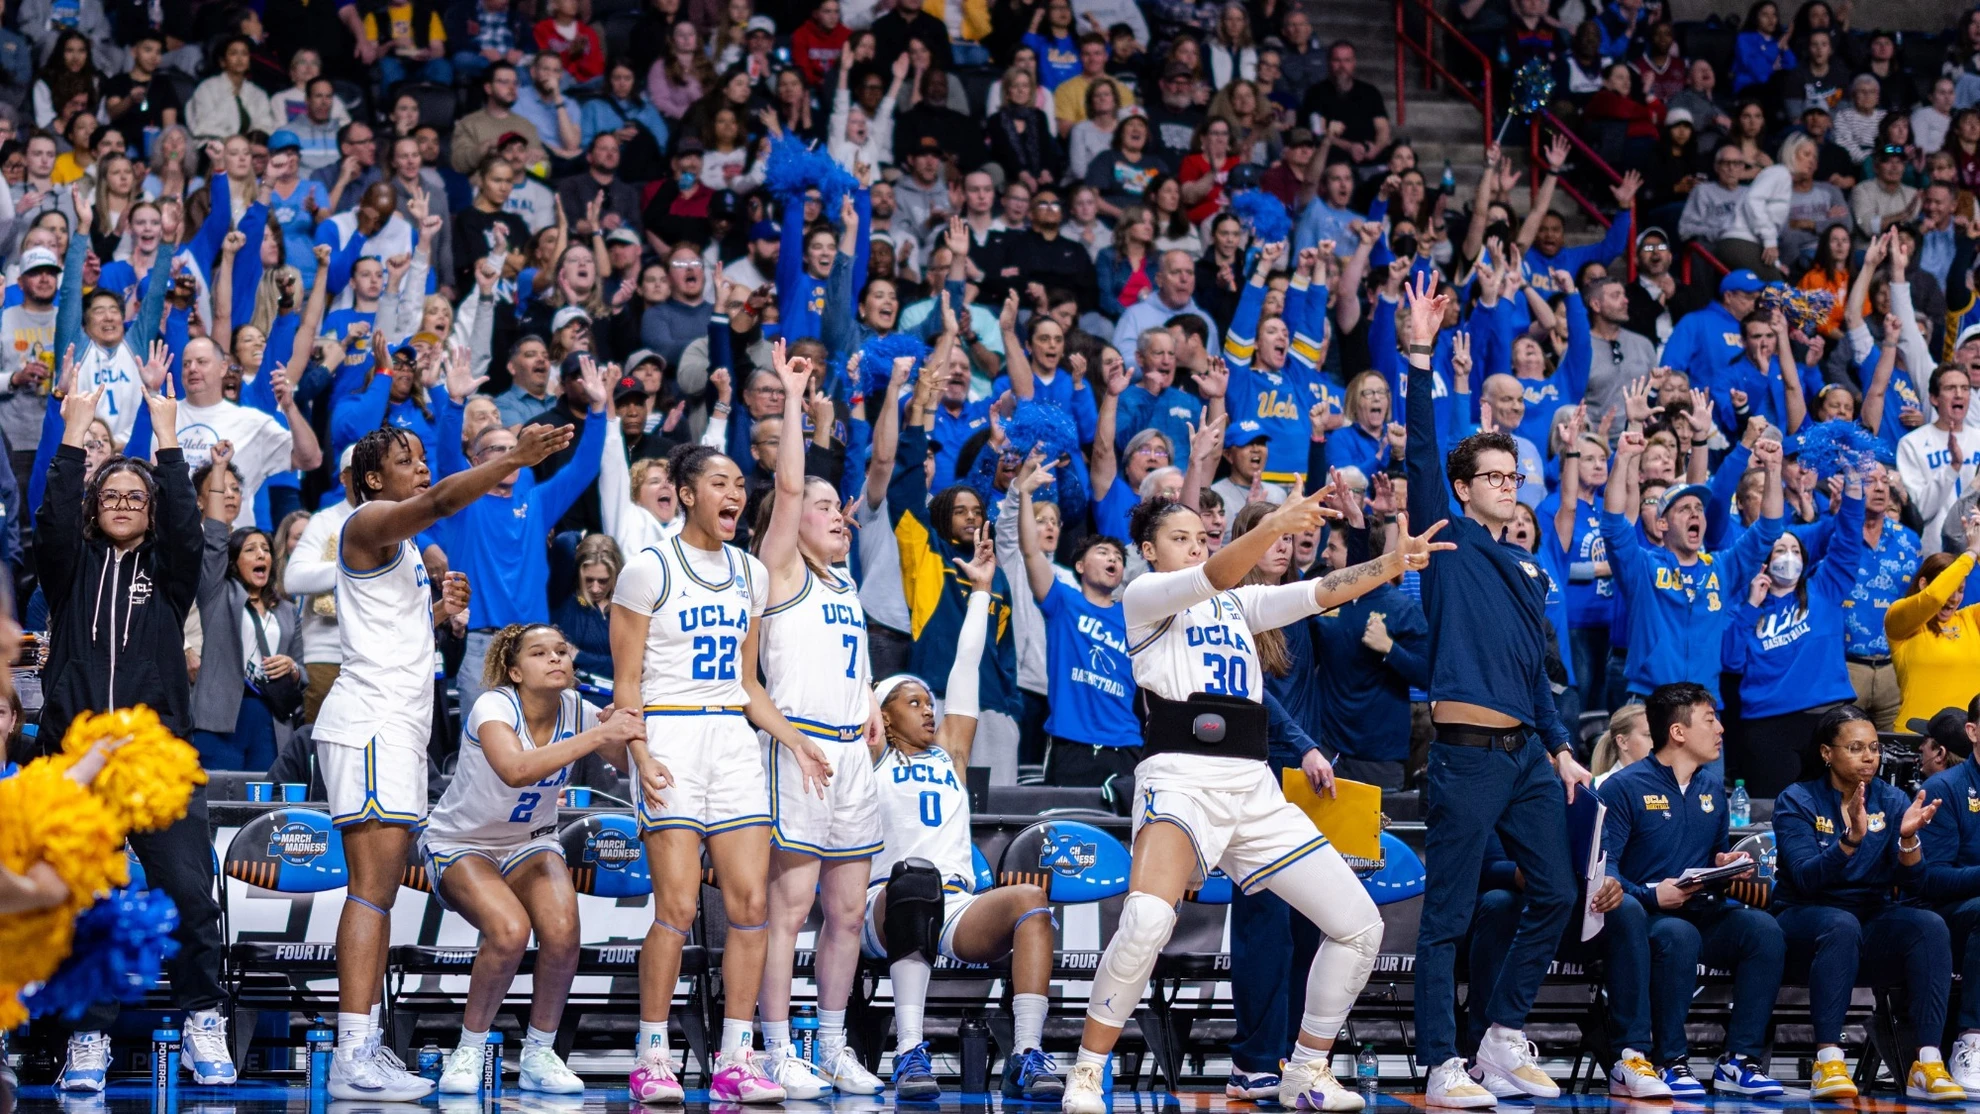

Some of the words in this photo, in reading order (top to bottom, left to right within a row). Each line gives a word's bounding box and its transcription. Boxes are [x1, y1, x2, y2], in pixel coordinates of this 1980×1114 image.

[94, 369, 130, 385] UCLA
[106, 390, 119, 416] 1
[1257, 390, 1299, 420] Ucla
[183, 437, 207, 450] Ucla
[678, 605, 748, 633] UCLA
[822, 603, 867, 629] UCLA
[1186, 624, 1252, 656] UCLA
[692, 635, 738, 681] 22
[842, 633, 858, 679] 7
[1203, 652, 1249, 698] 30
[893, 763, 960, 791] UCLA
[508, 792, 541, 823] 2
[919, 790, 942, 828] 0
[281, 834, 312, 843] MARCH
[596, 839, 626, 849] MARCH
[285, 843, 327, 852] MADNESS
[600, 849, 641, 858] MADNESS
[275, 945, 315, 961] FOUR
[316, 945, 333, 961] IT
[433, 951, 473, 964] FOUR
[598, 947, 636, 964] FOUR
[797, 951, 812, 966] IT
[1061, 953, 1098, 969] FOUR
[1401, 956, 1416, 972] IT
[1562, 962, 1585, 975] ALL
